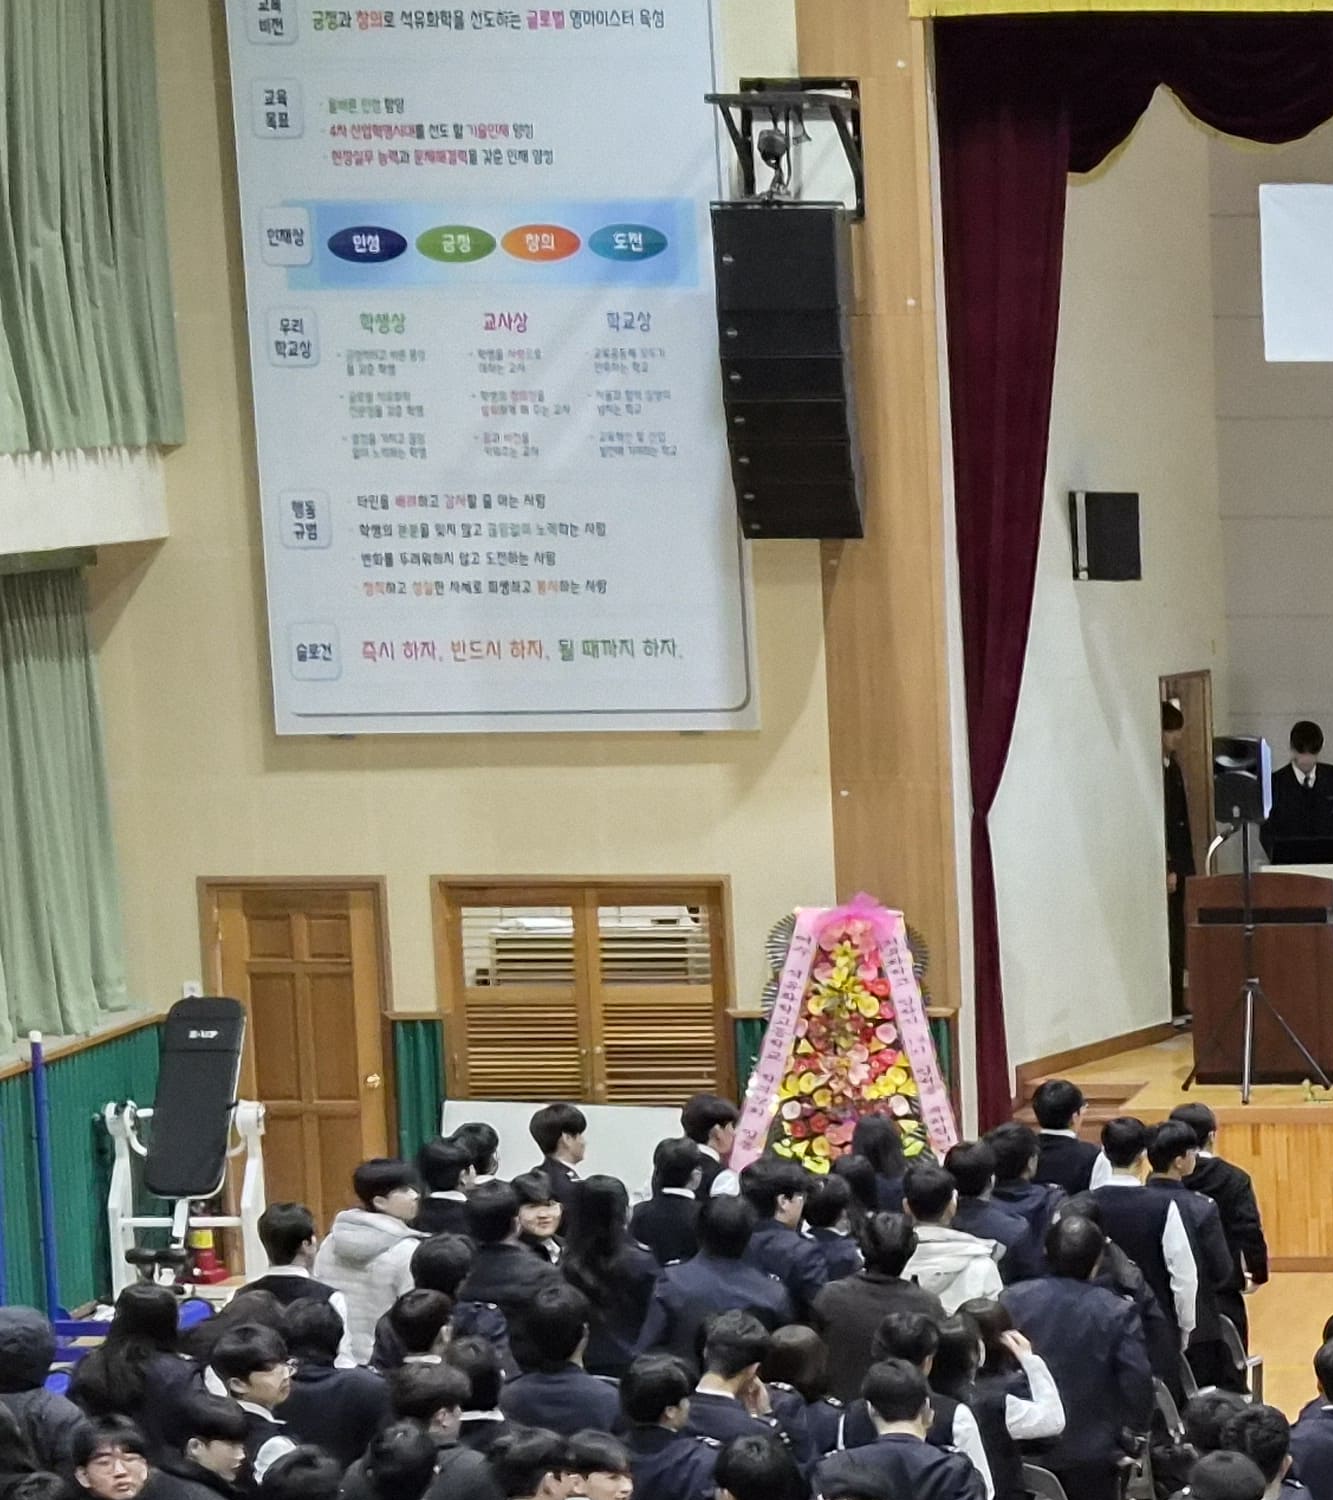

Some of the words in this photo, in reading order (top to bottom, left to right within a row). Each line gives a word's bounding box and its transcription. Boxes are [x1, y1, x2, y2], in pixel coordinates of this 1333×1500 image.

[259, 18, 284, 36] 비전
[312, 10, 352, 31] 긍정과
[356, 10, 396, 29] 창의로
[400, 10, 465, 30] 석유화학을
[470, 10, 521, 29] 선도하는
[526, 10, 565, 30] 글로벌
[569, 10, 634, 29] 영마이스터
[640, 9, 664, 29] 육성
[264, 89, 288, 107] 교육
[265, 112, 289, 129] 목표
[266, 226, 305, 247] 인재상
[352, 233, 380, 253] 인성
[442, 233, 471, 253] 긍정
[524, 232, 555, 252] 창의
[612, 231, 643, 252] 도전
[279, 318, 304, 336] 우리
[360, 313, 406, 334] 학생상
[483, 312, 529, 333] 교사상
[606, 312, 651, 332] 학교상
[274, 341, 312, 359] 학교상
[291, 500, 316, 521] 행동
[357, 495, 389, 510] 타인을
[395, 495, 440, 509] 배려하고
[444, 494, 477, 510] 감사할
[498, 494, 520, 509] 아는
[524, 494, 546, 510] 사람
[293, 523, 318, 541] 규범
[359, 523, 393, 537] 학생의
[535, 523, 579, 537] 노력하는
[584, 523, 607, 537] 사람
[361, 552, 394, 568] 변화를
[399, 552, 455, 566] 두려워하지
[485, 551, 529, 567] 도전하는
[534, 551, 556, 566] 사람
[585, 579, 607, 594] 사람
[296, 643, 332, 662] 슬로건
[362, 641, 394, 662] 즉시
[451, 640, 502, 662] 반드시
[559, 639, 574, 661] 될
[582, 639, 634, 658] 때까지
